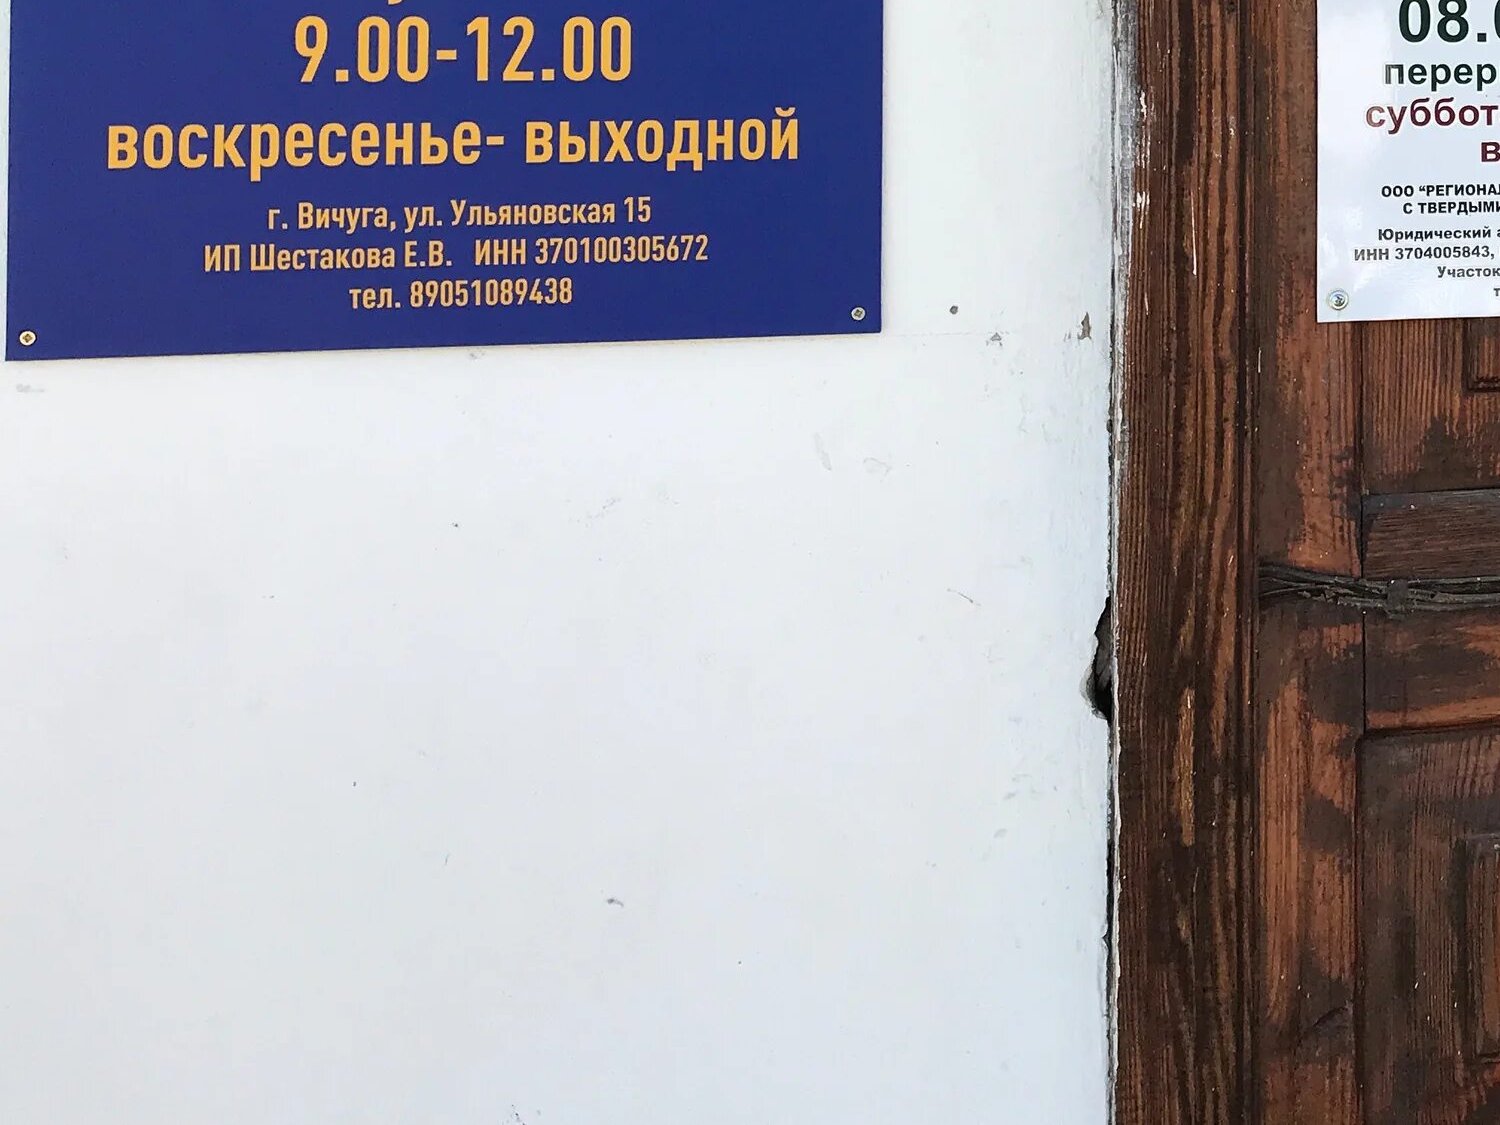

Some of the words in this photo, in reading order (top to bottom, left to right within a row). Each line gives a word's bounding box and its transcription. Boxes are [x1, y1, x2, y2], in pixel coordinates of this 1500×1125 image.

[295, 16, 631, 82] 9.00-12.00
[108, 122, 504, 181] воскресенье-
[526, 107, 797, 171] выходной
[1381, 185, 1414, 197] ООО
[269, 209, 287, 229] г.
[299, 203, 396, 234] Вичуга,
[404, 207, 442, 233] ул.
[451, 200, 614, 225] Ульяновская
[624, 197, 650, 222] 15
[1403, 202, 1413, 214] С
[1378, 226, 1491, 243] Юридический
[205, 245, 239, 271] ИП
[251, 244, 394, 270] Шестакова
[405, 241, 451, 267] Е.В.
[476, 239, 525, 265] ИНН
[536, 235, 707, 264] 370100305672
[1354, 248, 1389, 261] ИНН
[1395, 245, 1494, 260] 3704005843,
[1437, 266, 1500, 278] Участок
[349, 289, 400, 308] тел.
[411, 278, 572, 307] 89051089438
